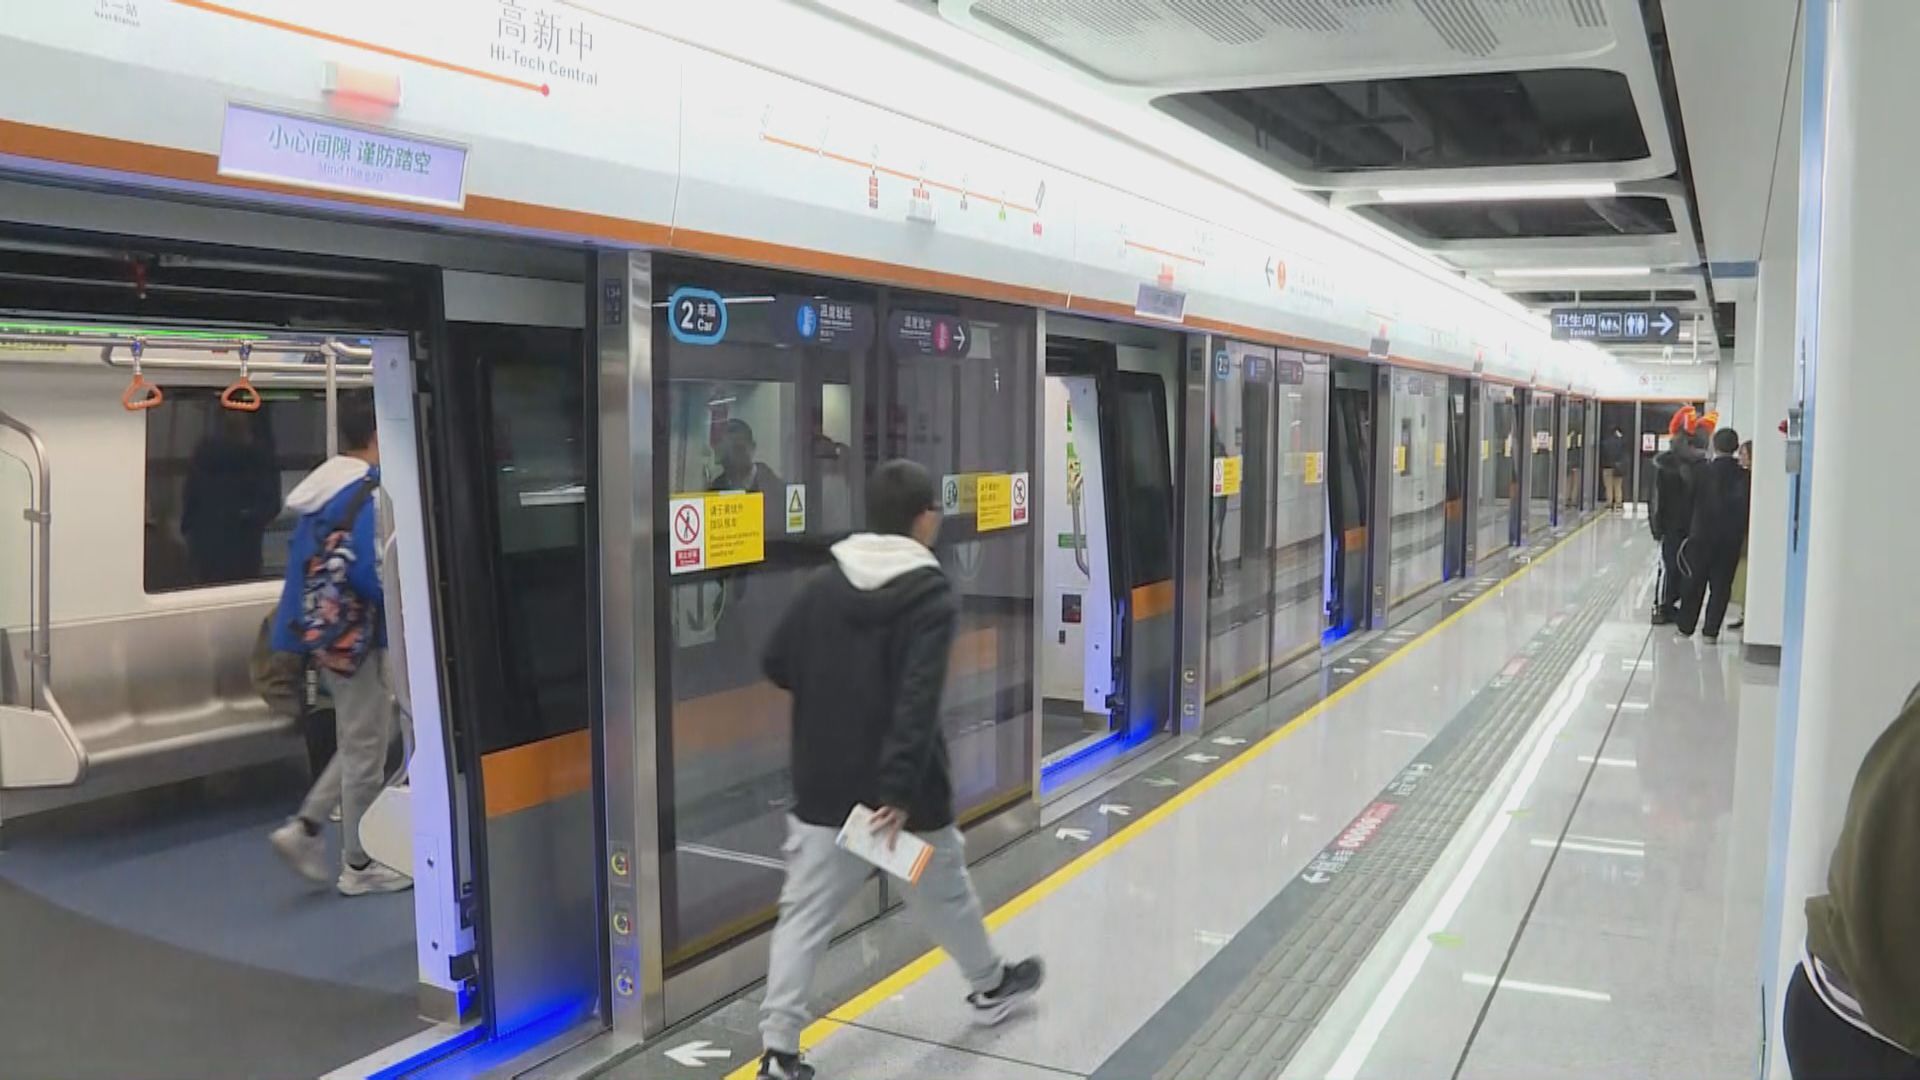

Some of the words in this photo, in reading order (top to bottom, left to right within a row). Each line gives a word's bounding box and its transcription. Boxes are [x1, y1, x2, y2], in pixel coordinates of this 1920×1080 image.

[498, 0, 593, 61] 高新中
[490, 43, 545, 73] Hi-Tech
[549, 59, 598, 87] Central
[269, 124, 352, 162] 小心间隙
[357, 139, 432, 175] 谨防踏空
[681, 300, 694, 330] 2
[697, 303, 717, 318] 车厢
[697, 318, 714, 332] Car
[1555, 313, 1597, 328] 卫生间
